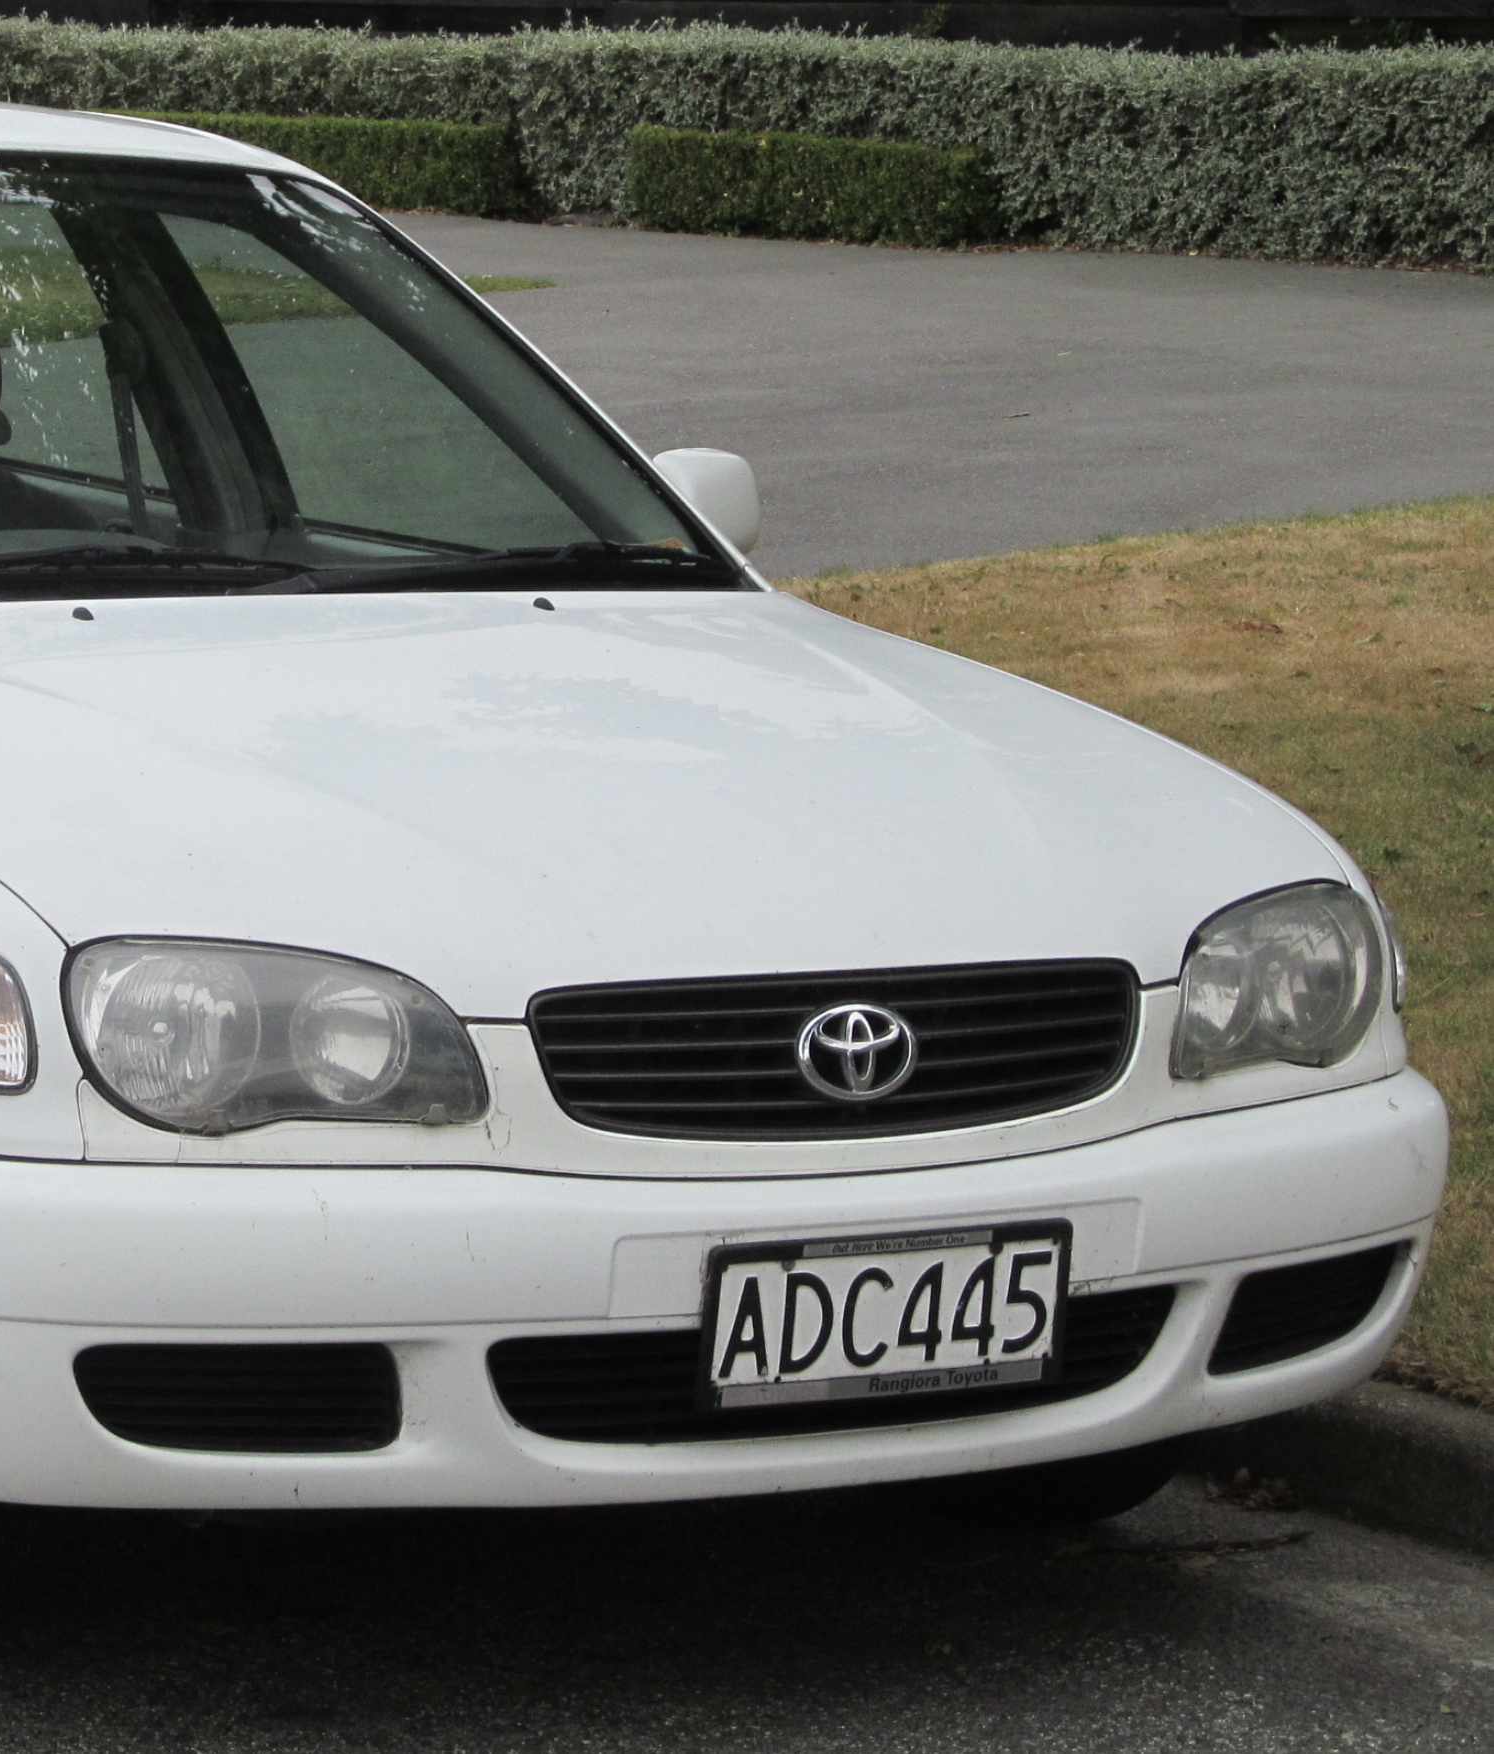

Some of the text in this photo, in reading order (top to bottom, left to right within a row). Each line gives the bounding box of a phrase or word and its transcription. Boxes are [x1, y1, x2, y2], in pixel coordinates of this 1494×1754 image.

[876, 1239, 903, 1250] We're
[906, 1236, 943, 1248] Number
[946, 1234, 966, 1245] One
[718, 1250, 1053, 1379] ADC445
[868, 1368, 999, 1392] Rangiora Toyota
